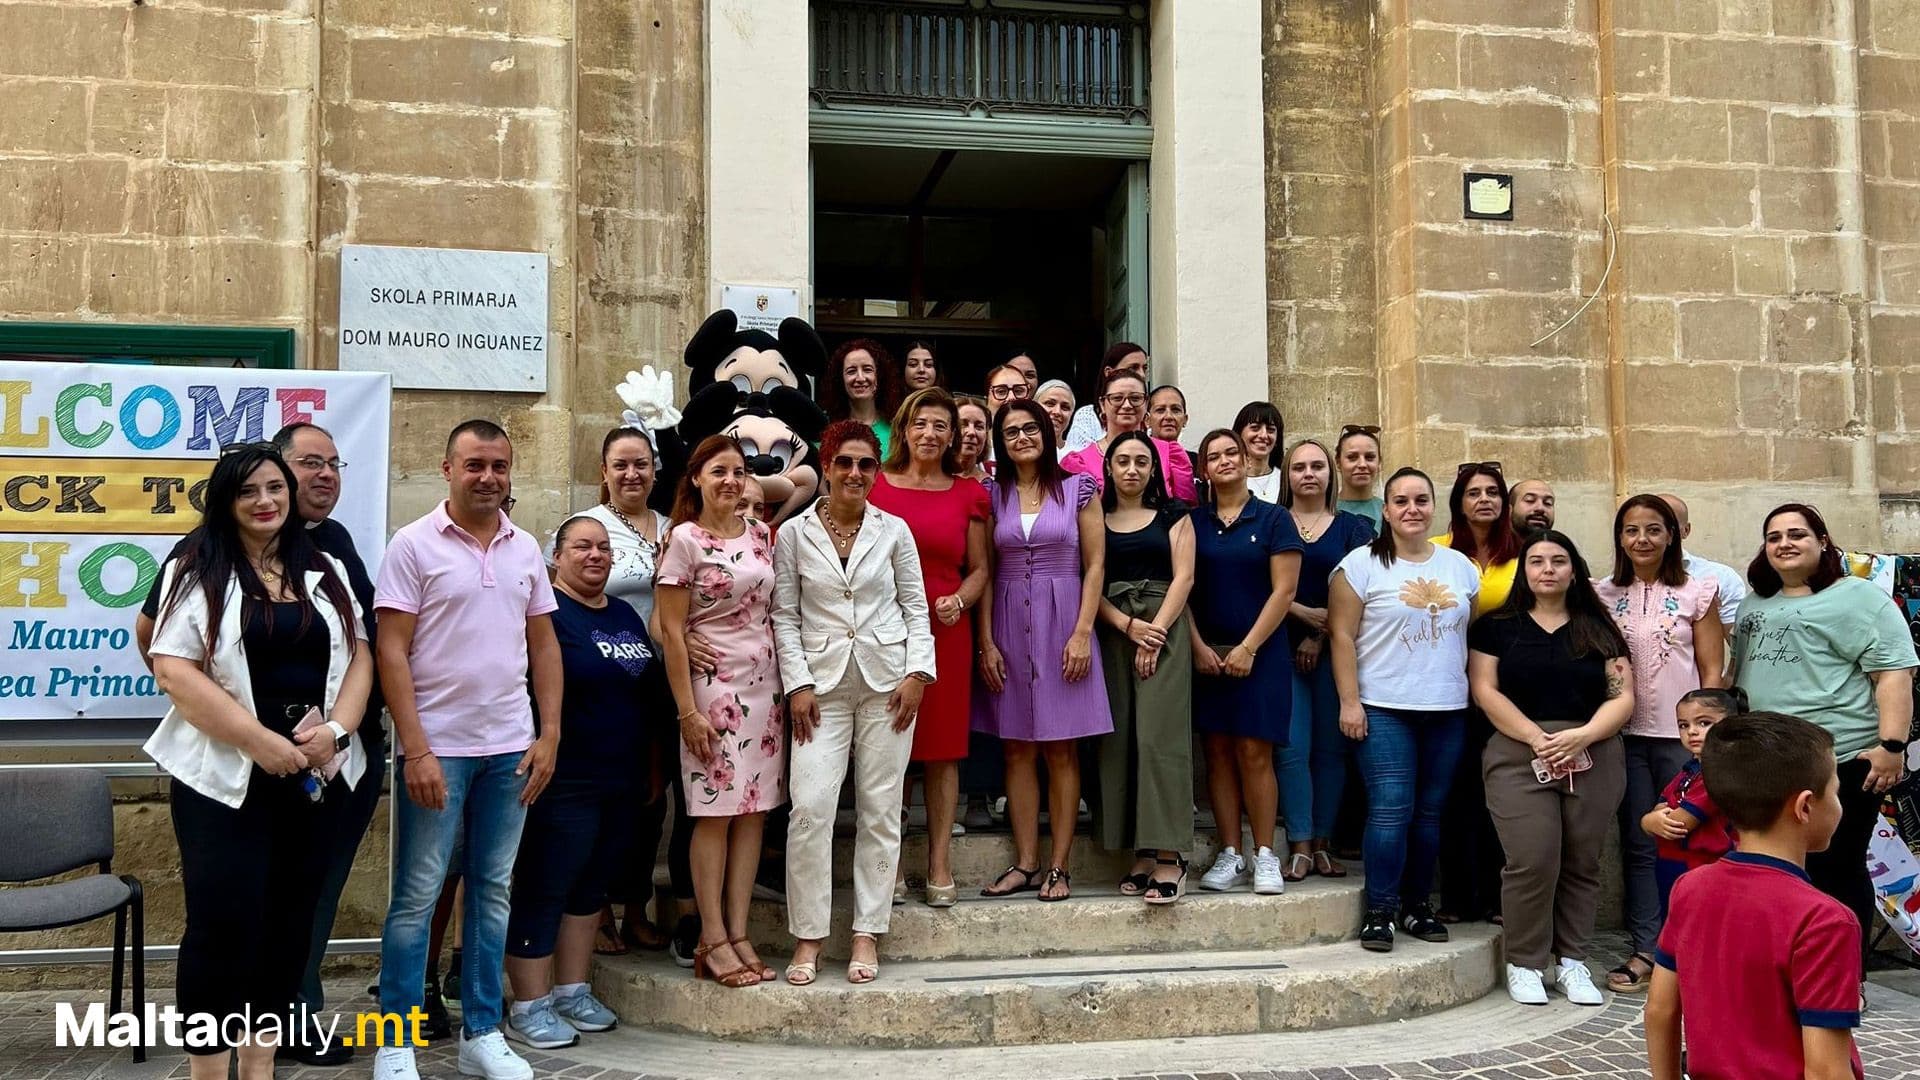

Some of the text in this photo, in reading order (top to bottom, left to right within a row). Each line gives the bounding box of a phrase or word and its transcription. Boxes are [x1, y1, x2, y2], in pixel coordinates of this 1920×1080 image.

[370, 288, 517, 308] SKOLA PRIMARJA
[343, 329, 543, 351] DOM MAURO INGUANEZ
[8, 620, 130, 650] Mauro
[1398, 616, 1430, 653] Feel
[1757, 624, 1797, 649] just
[596, 641, 653, 659] PARIS
[1748, 645, 1802, 666] breathe
